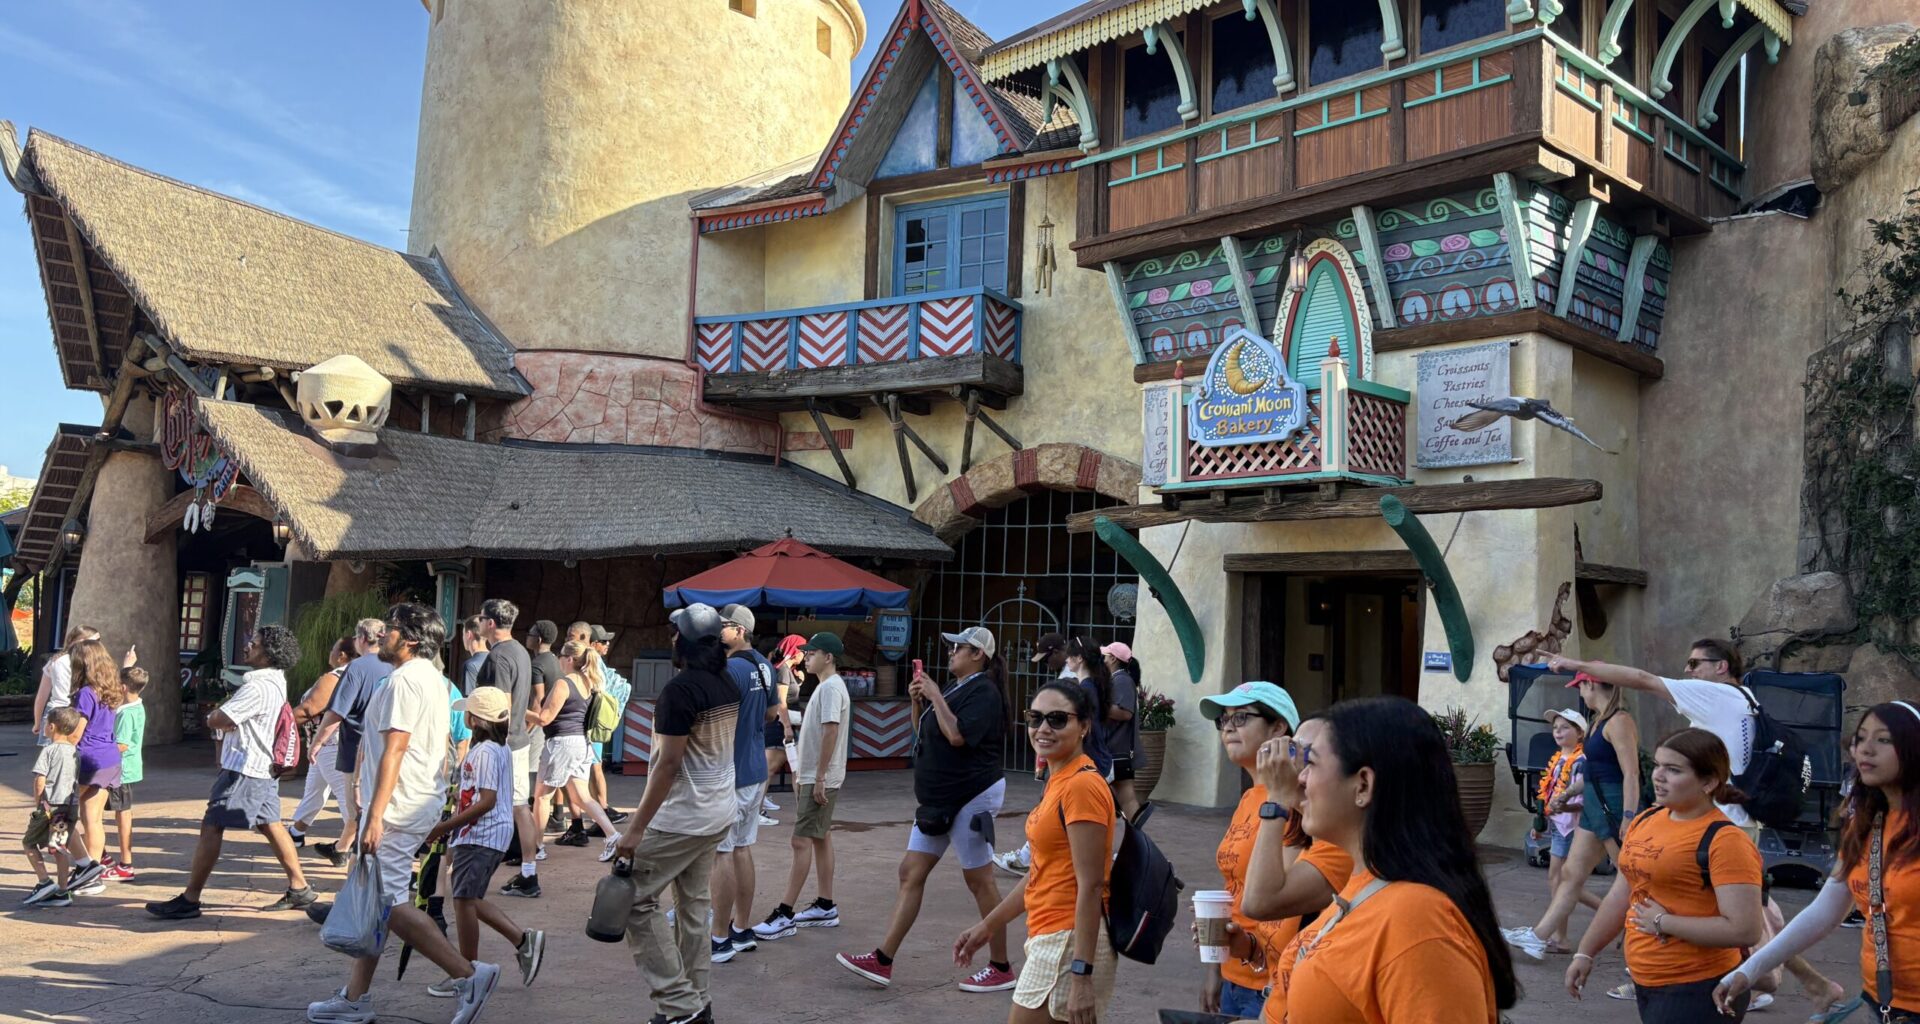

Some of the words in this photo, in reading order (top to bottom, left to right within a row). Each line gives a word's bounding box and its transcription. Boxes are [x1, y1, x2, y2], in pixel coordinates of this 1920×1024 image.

[1437, 362, 1490, 376] Croissants
[1443, 378, 1486, 392] Pastries
[1200, 399, 1253, 420] Croissant
[1255, 396, 1291, 414] Moon
[1216, 417, 1272, 435] Bakery
[1425, 434, 1460, 453] Coffee
[1461, 432, 1482, 446] and
[1484, 428, 1502, 447] Tea
[285, 721, 297, 768] Columbi
